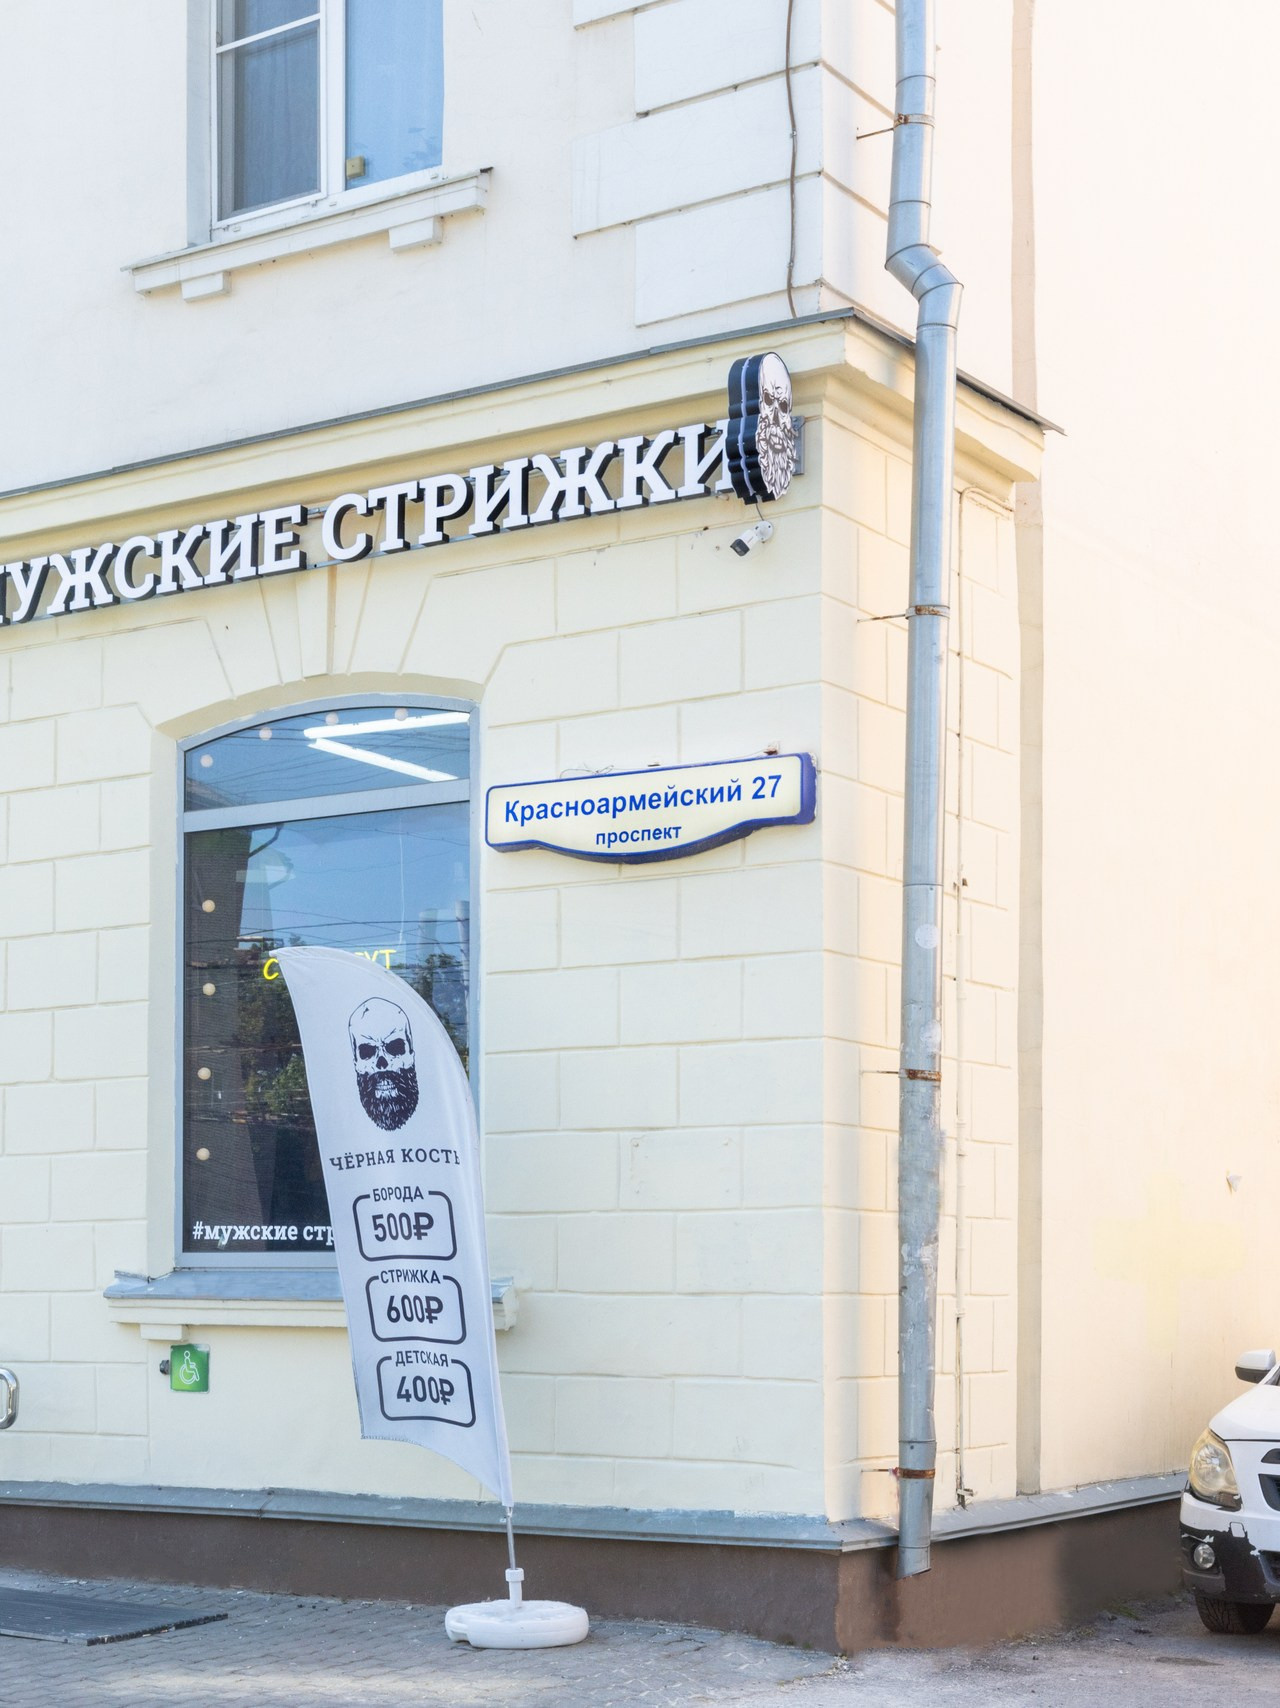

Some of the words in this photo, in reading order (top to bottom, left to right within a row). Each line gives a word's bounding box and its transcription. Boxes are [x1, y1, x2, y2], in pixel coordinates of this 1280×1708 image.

[322, 419, 732, 562] СТРИЖКИ
[505, 779, 742, 826] Красноармейский
[751, 774, 783, 800] 27
[596, 824, 682, 848] проспект
[329, 1149, 396, 1171] ЧЁРНАЯ
[372, 1186, 424, 1203] БОРОДА
[192, 1221, 298, 1245] #мужские
[371, 1211, 434, 1242] 500₽
[380, 1269, 441, 1284] СТРИЖКА
[387, 1294, 443, 1324] 600₽
[395, 1350, 449, 1368] ДЕТСКАЯ
[397, 1375, 454, 1405] 400₽
